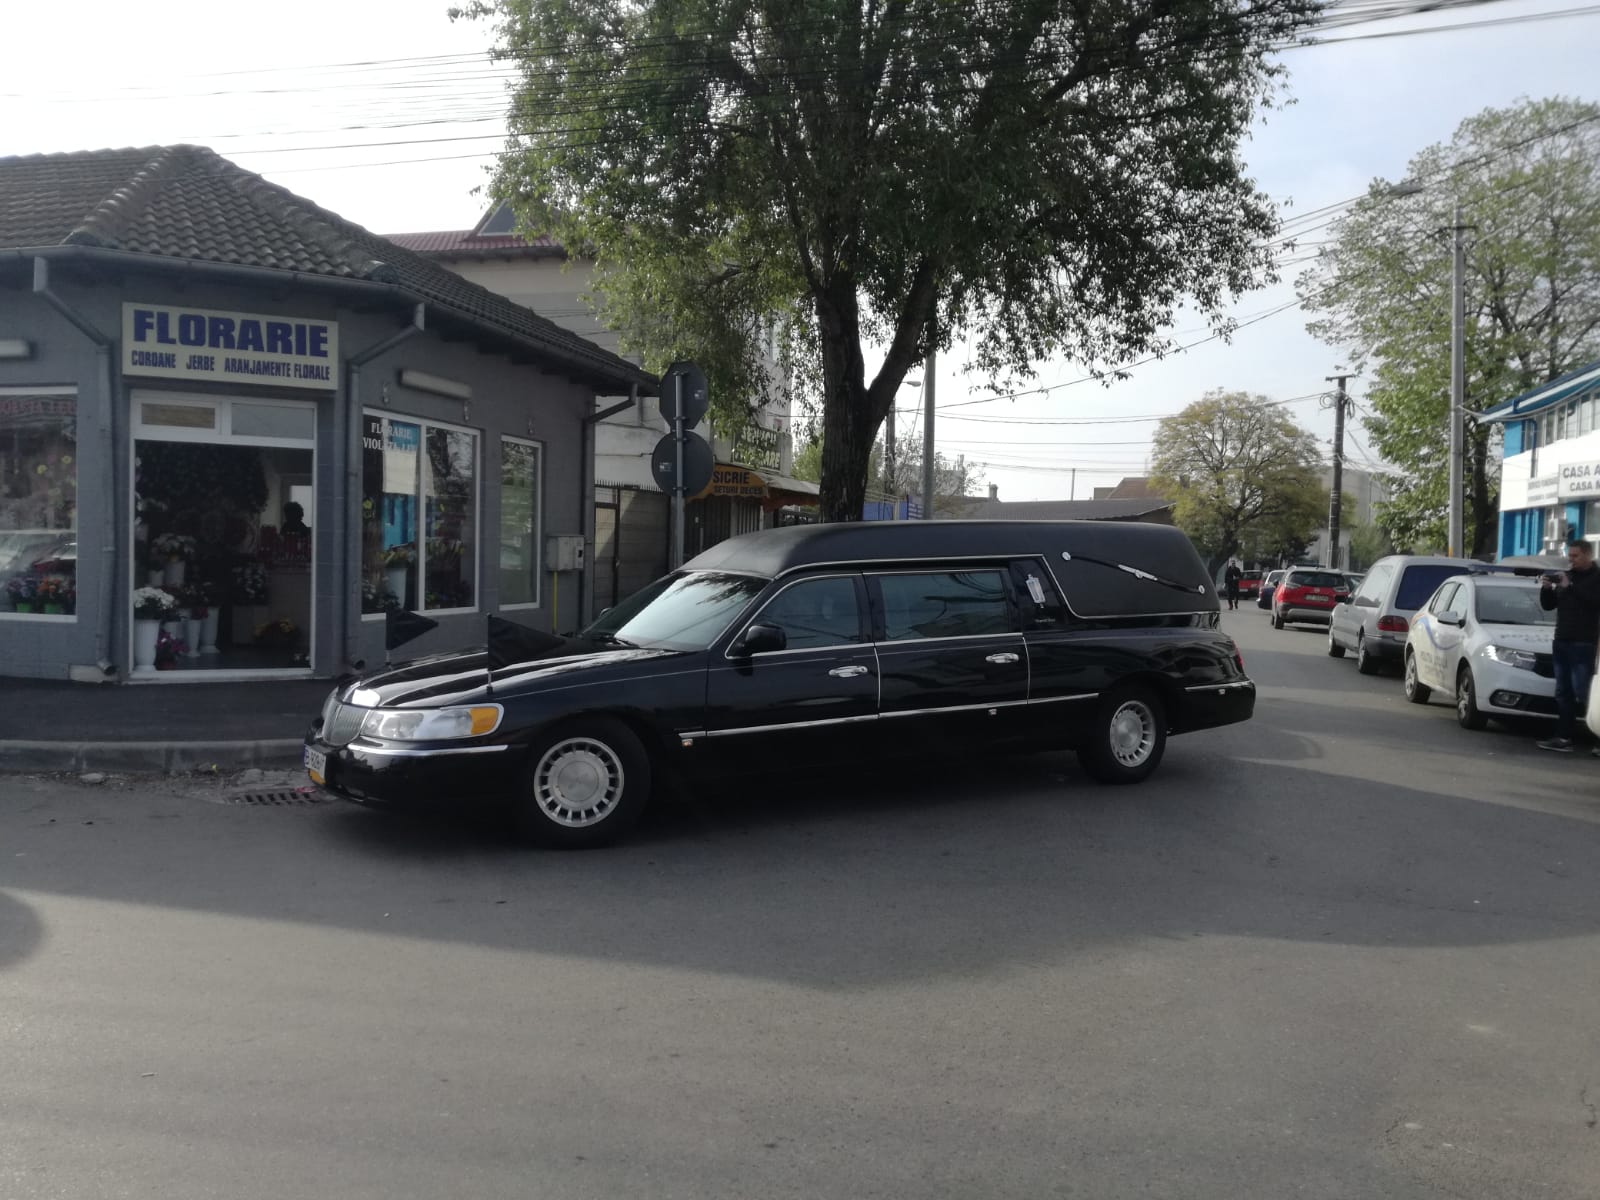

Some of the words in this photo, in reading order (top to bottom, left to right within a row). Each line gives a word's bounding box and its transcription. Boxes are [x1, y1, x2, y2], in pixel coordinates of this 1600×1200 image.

[133, 309, 329, 358] FLORARIE
[186, 354, 215, 372] JERBE
[224, 357, 291, 378] ARANJAMENTE
[293, 363, 330, 381] FLORALE
[371, 422, 413, 441] FLRARIE
[713, 471, 748, 484] SICRIE
[1563, 465, 1591, 479] CASA
[1569, 481, 1593, 492] CASA
